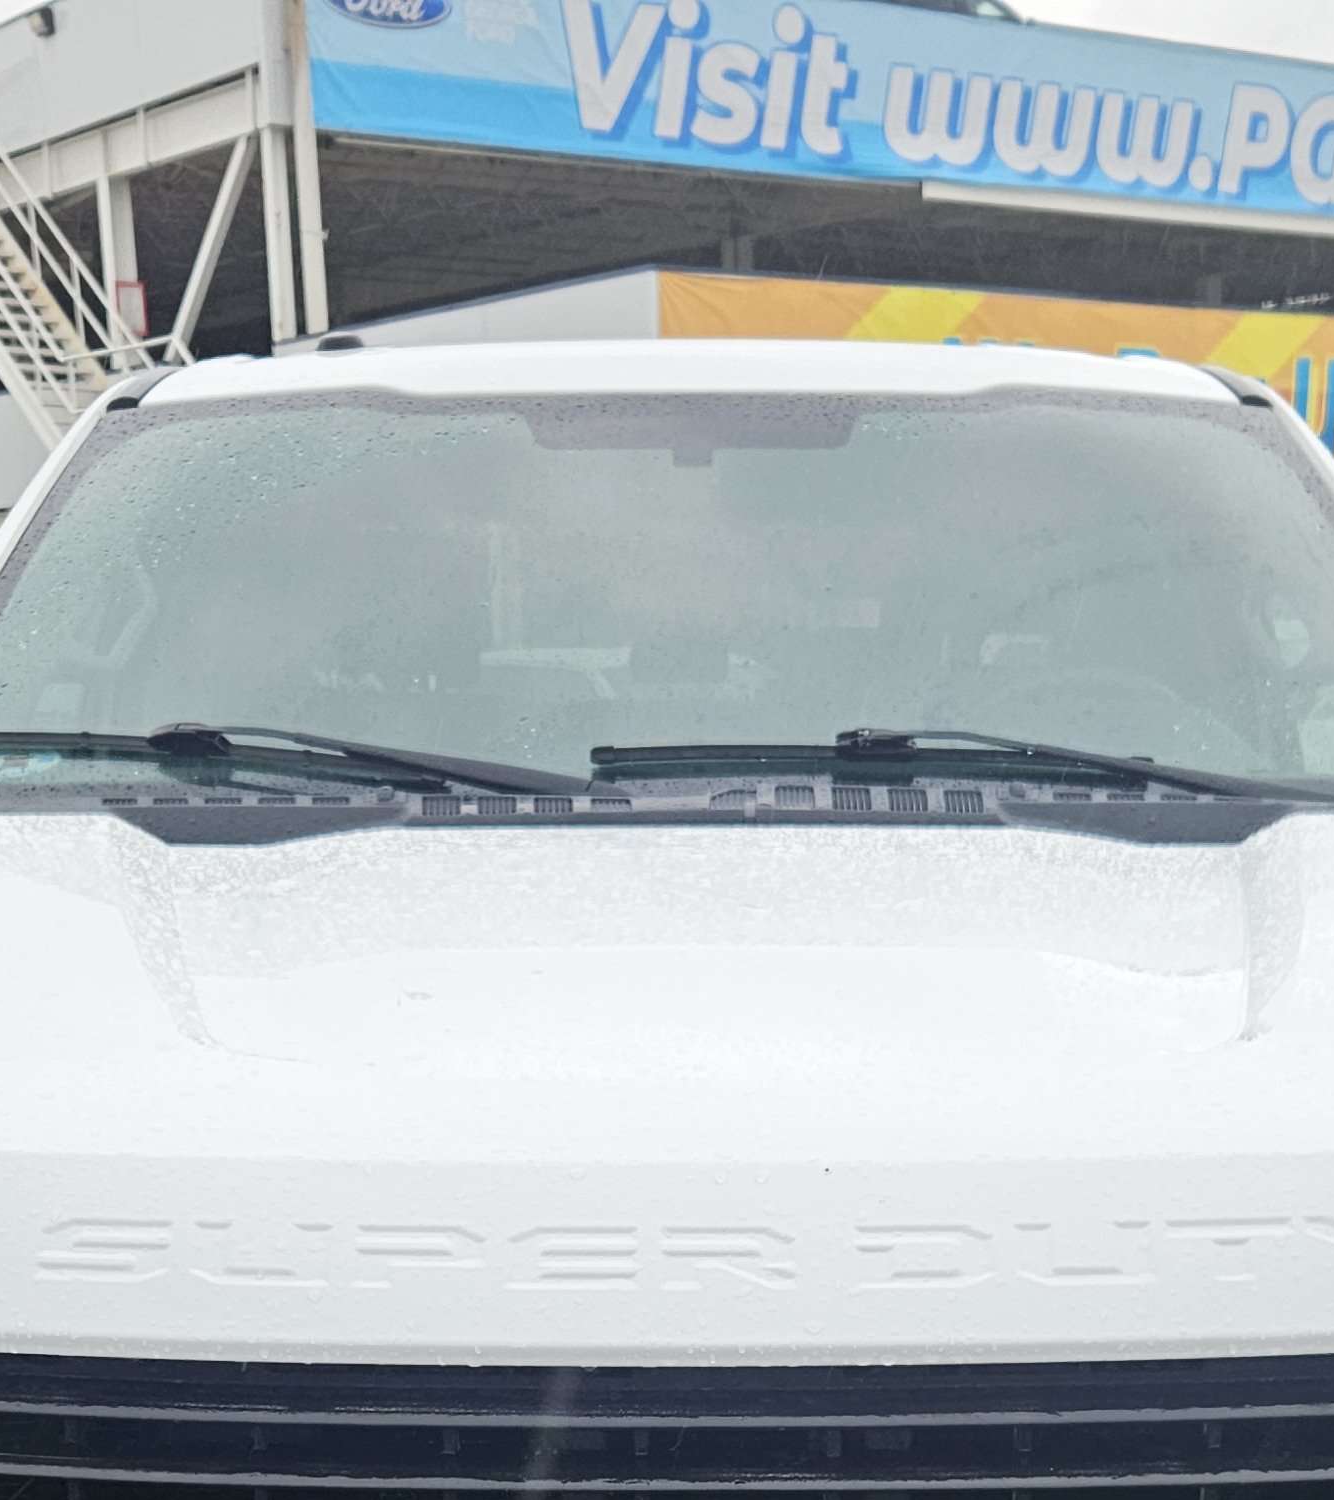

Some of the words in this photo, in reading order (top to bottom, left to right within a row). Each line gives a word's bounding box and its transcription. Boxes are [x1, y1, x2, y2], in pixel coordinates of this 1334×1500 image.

[343, 0, 427, 20] ord
[561, 0, 847, 156] Visit
[33, 1215, 799, 1292] SUPER
